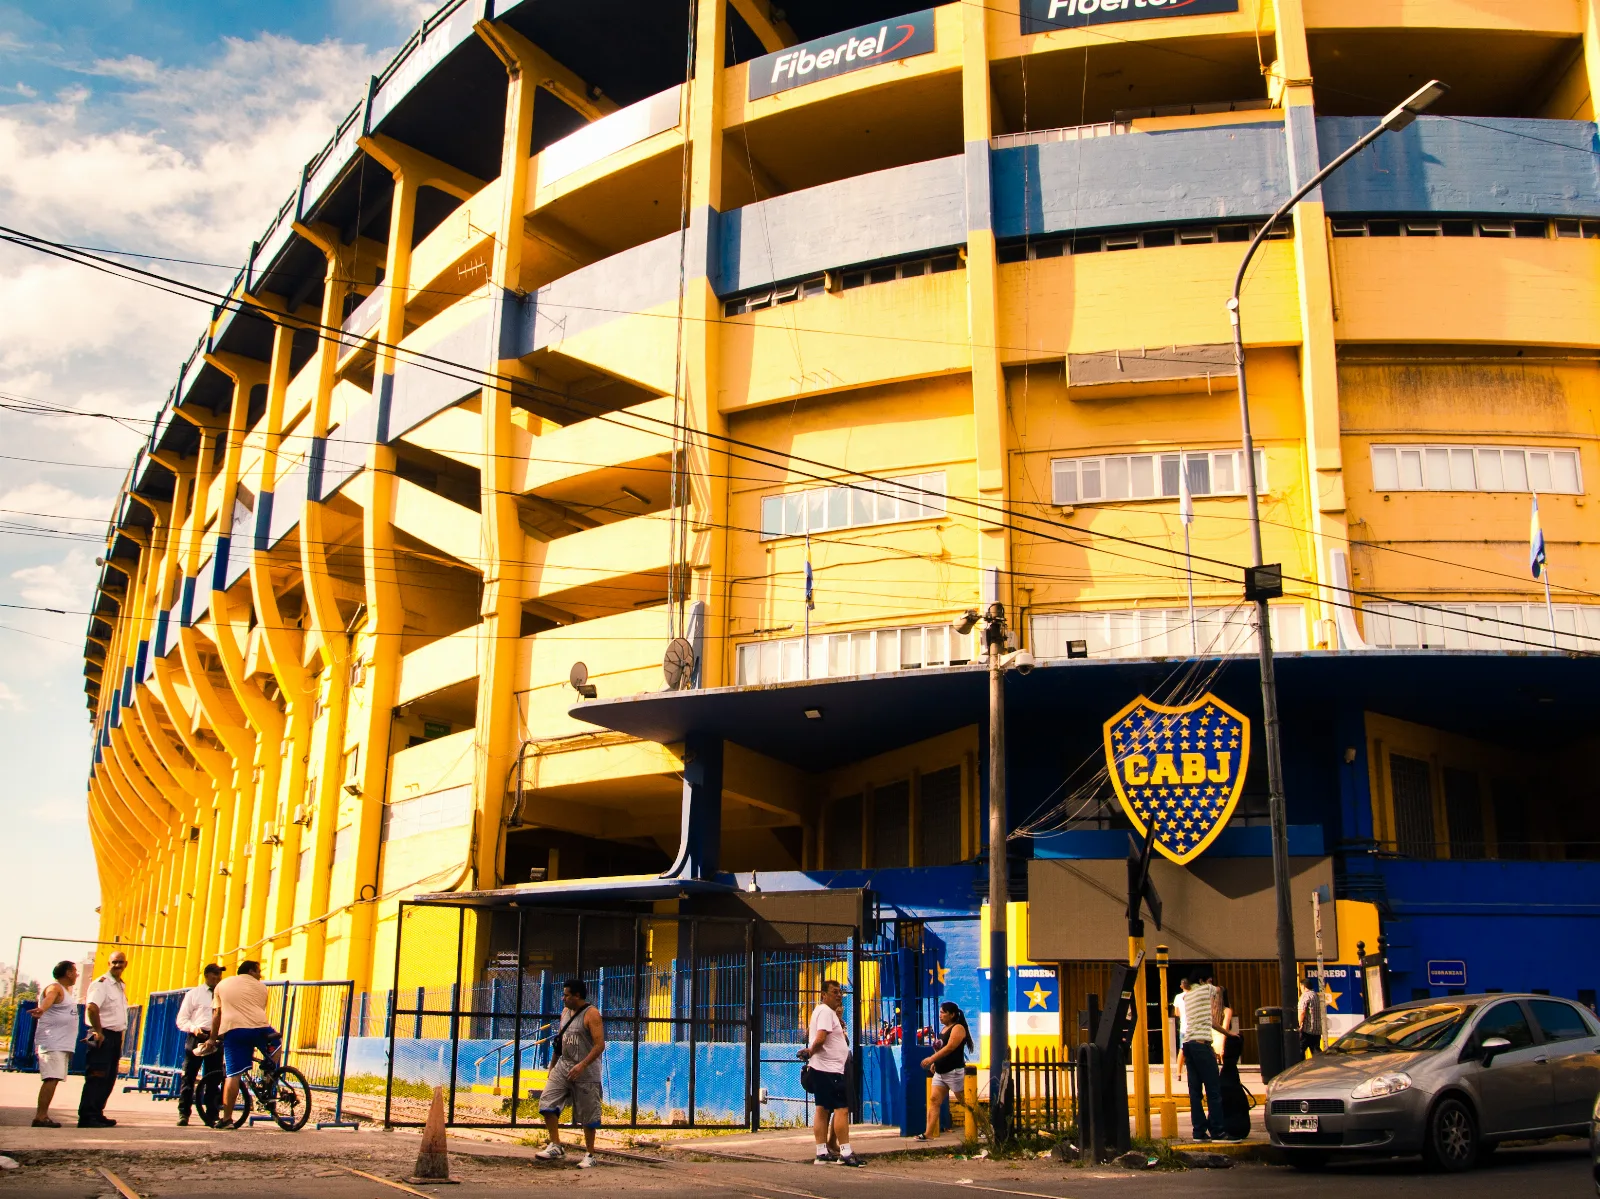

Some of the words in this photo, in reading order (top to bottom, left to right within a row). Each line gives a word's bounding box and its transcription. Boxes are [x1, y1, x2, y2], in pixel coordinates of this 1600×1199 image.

[770, 26, 888, 83] Fibertel
[1124, 751, 1231, 786] CABJ
[1307, 969, 1347, 978] INRESO
[1033, 992, 1042, 1003] 3
